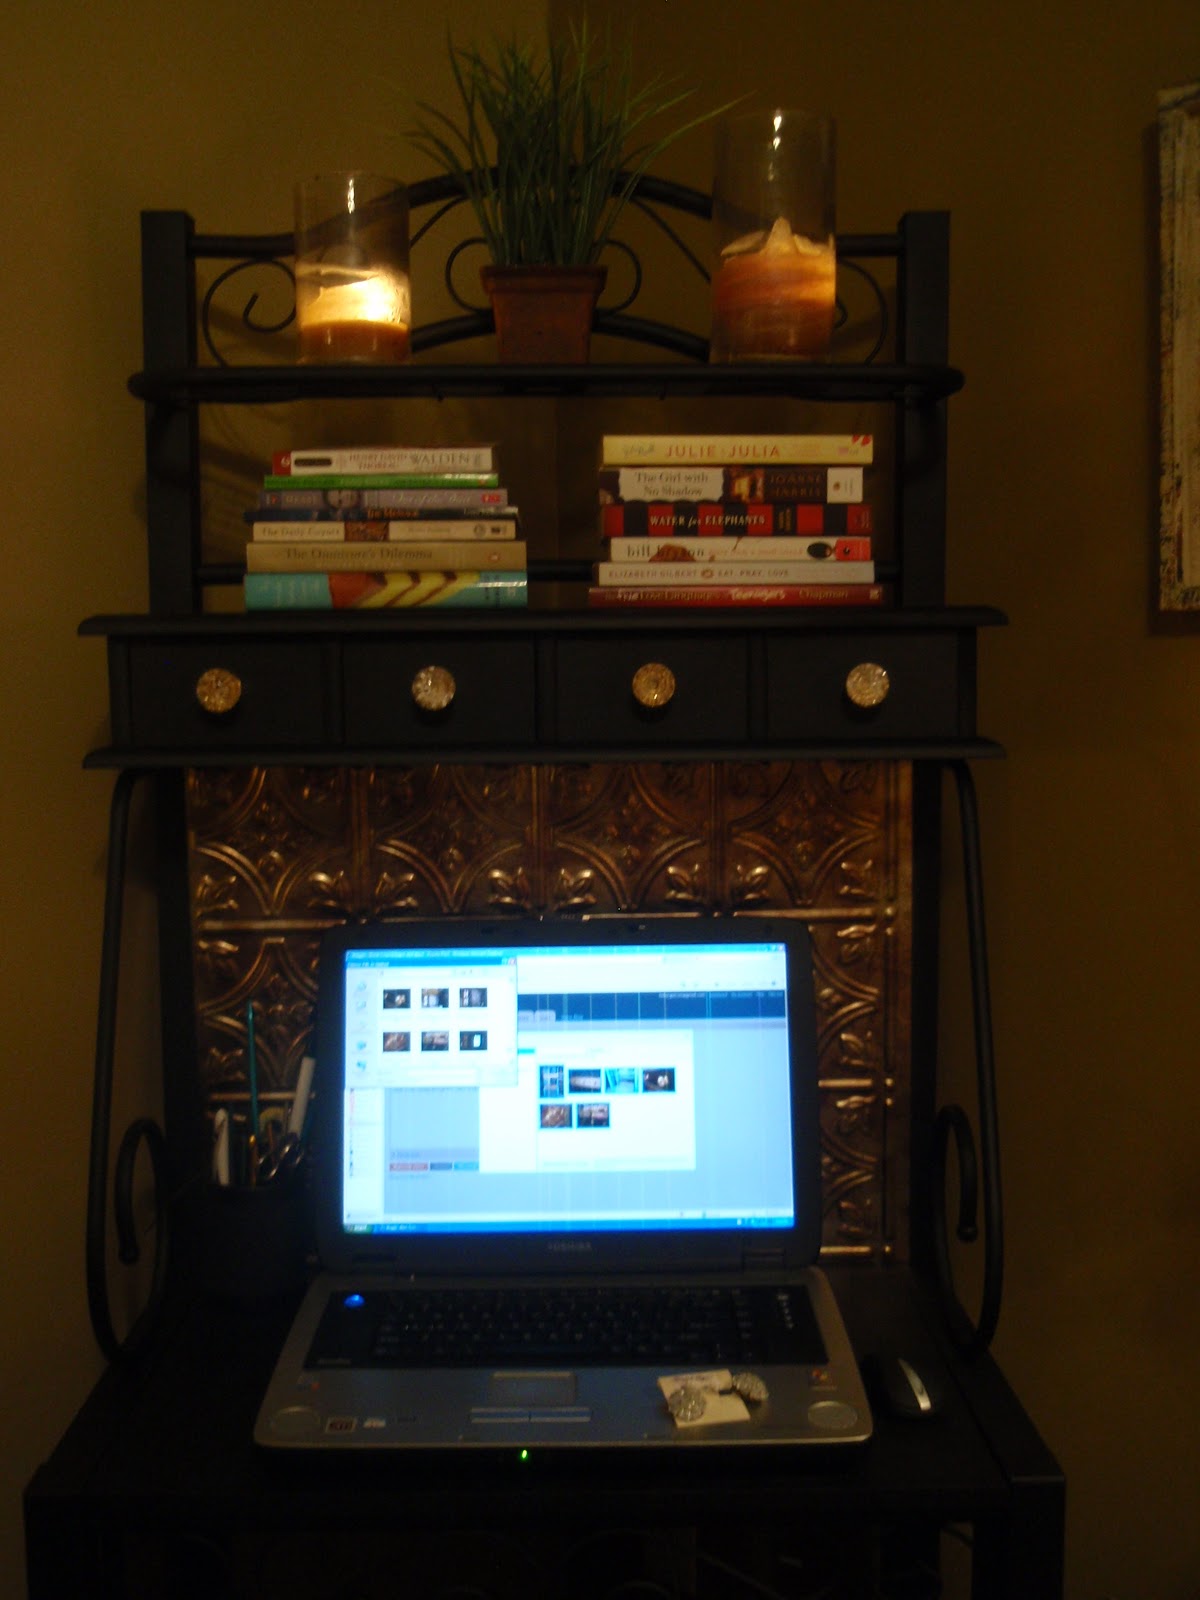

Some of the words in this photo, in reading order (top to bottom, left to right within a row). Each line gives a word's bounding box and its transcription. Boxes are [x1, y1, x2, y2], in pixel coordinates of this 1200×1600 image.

[667, 445, 716, 458] JULIE
[729, 445, 780, 458] JULIA
[410, 453, 470, 464] WALDEN
[635, 472, 658, 483] The
[659, 472, 681, 483] Girl
[684, 472, 709, 483] with
[643, 486, 660, 496] No
[662, 486, 703, 496] Shadow
[650, 515, 685, 526] WATER
[705, 514, 766, 526] ELEPHANTS
[286, 547, 309, 560] The
[380, 547, 433, 560] Dilemma
[627, 544, 650, 557] bill
[799, 589, 848, 600] Chapman
